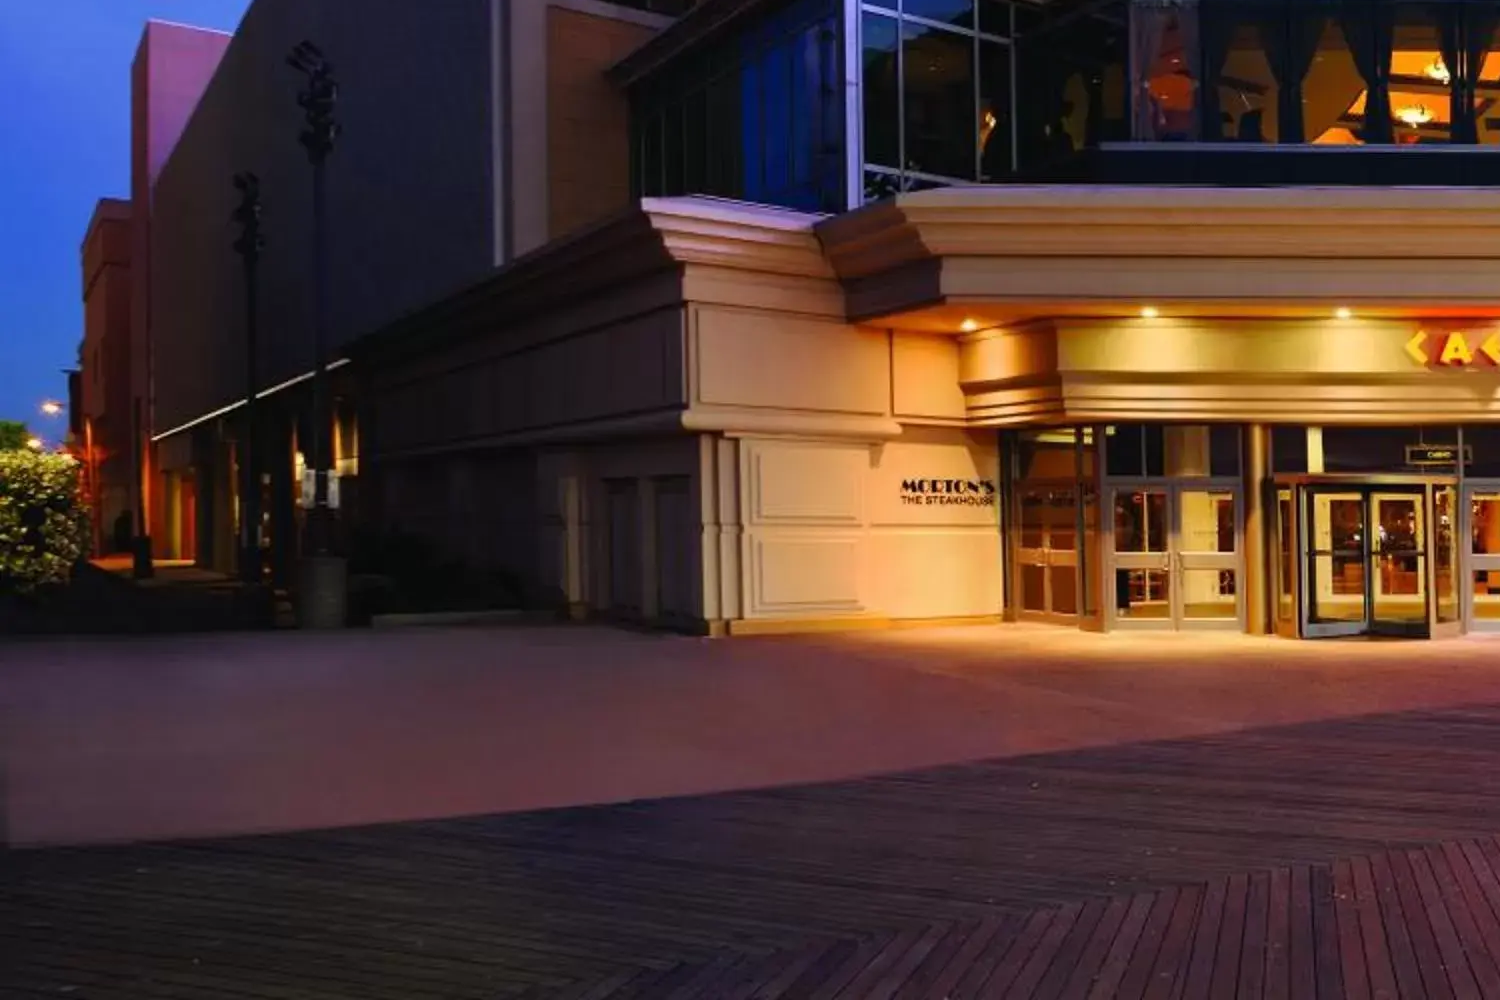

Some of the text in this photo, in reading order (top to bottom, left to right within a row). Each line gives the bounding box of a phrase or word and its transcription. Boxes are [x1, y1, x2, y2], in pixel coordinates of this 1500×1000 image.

[901, 479, 995, 493] MORTON'S
[901, 495, 995, 506] THE STEAKHOUSE
